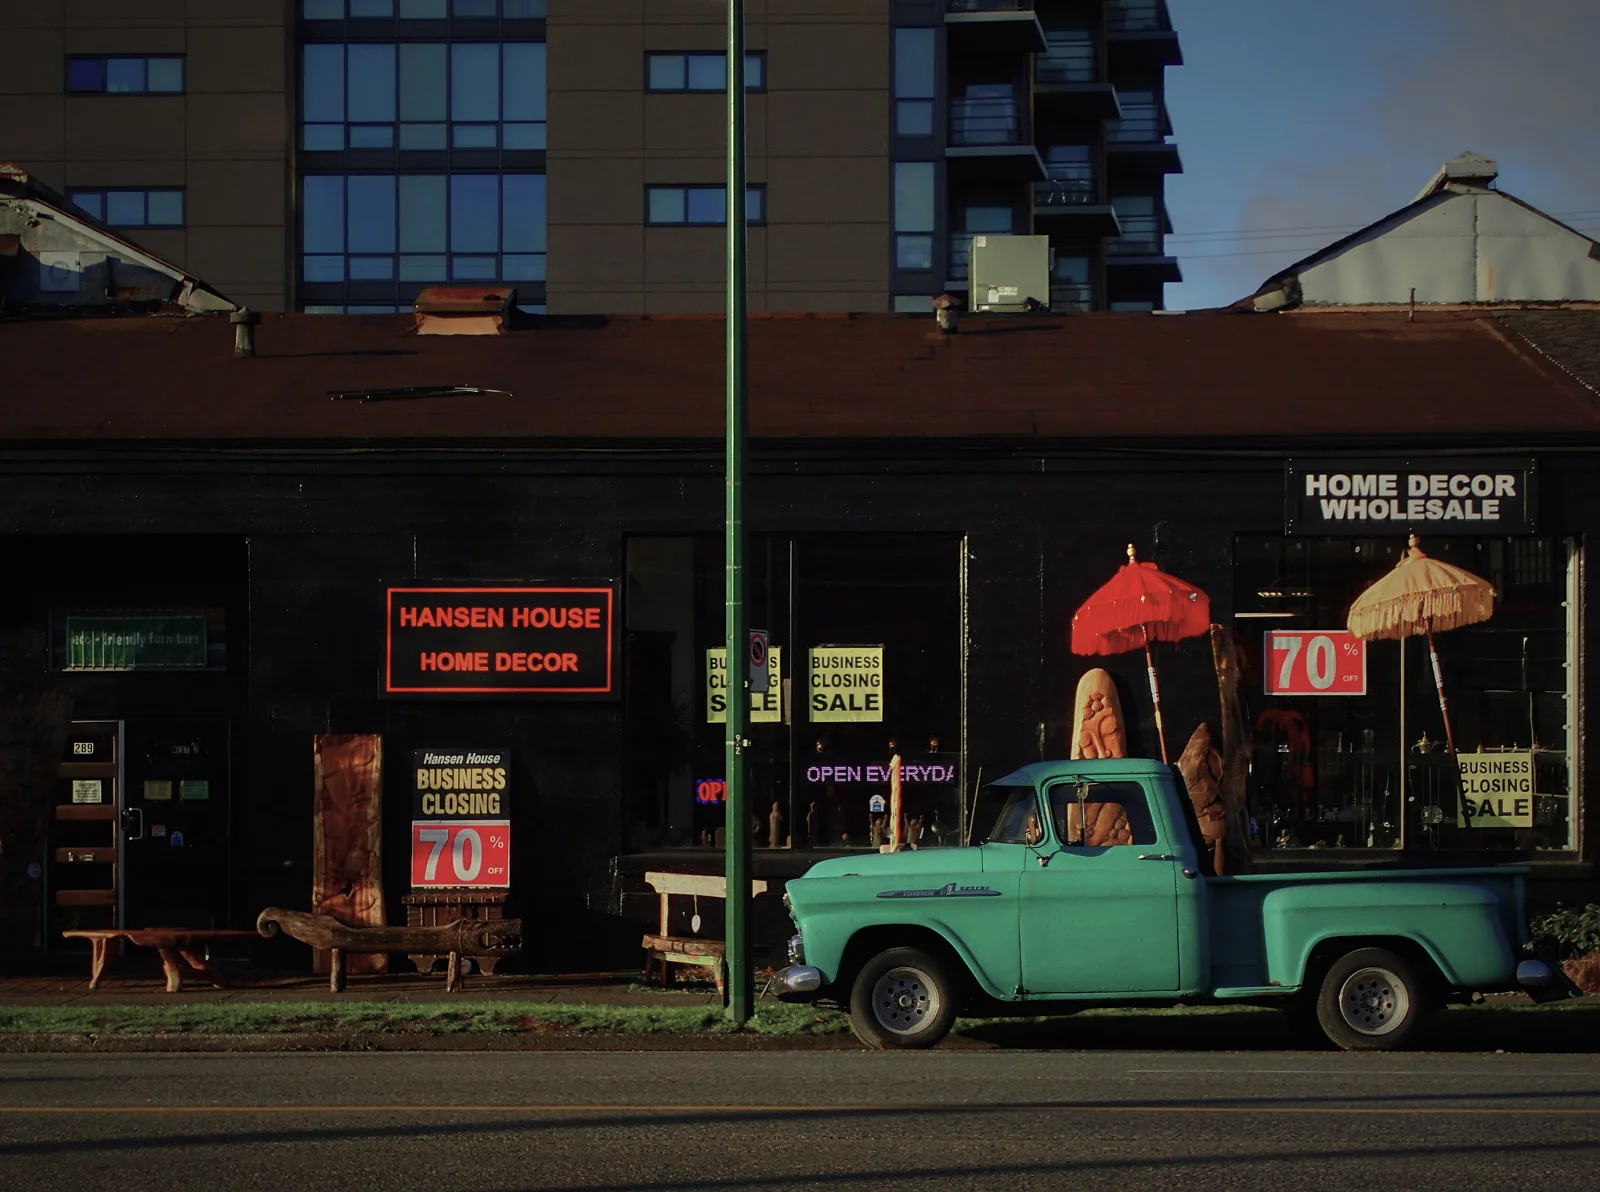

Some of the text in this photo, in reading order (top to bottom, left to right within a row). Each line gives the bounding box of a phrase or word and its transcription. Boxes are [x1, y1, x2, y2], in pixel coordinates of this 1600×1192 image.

[1305, 474, 1517, 497] HOME DECOR
[1320, 499, 1500, 520] WHOLESALE
[400, 606, 601, 629] HANSEN HOUSE
[149, 632, 200, 645] furnture
[420, 652, 579, 672] HOME DECOR
[812, 656, 880, 669] BUSINESS
[1272, 635, 1359, 689] 70 %
[811, 673, 880, 688] CLOSING
[710, 693, 778, 712] SLE
[812, 693, 880, 711] SALE
[75, 743, 93, 753] 289
[423, 753, 501, 765] Hansen House
[1460, 761, 1529, 774] BUSINESS
[416, 767, 507, 790] BUSINESS
[806, 765, 861, 783] OPEN
[1461, 778, 1530, 793] CLOSING
[421, 792, 501, 815] CLOSING
[1461, 798, 1529, 817] SALE
[419, 828, 504, 881] 70 %
[487, 867, 505, 875] OFF
